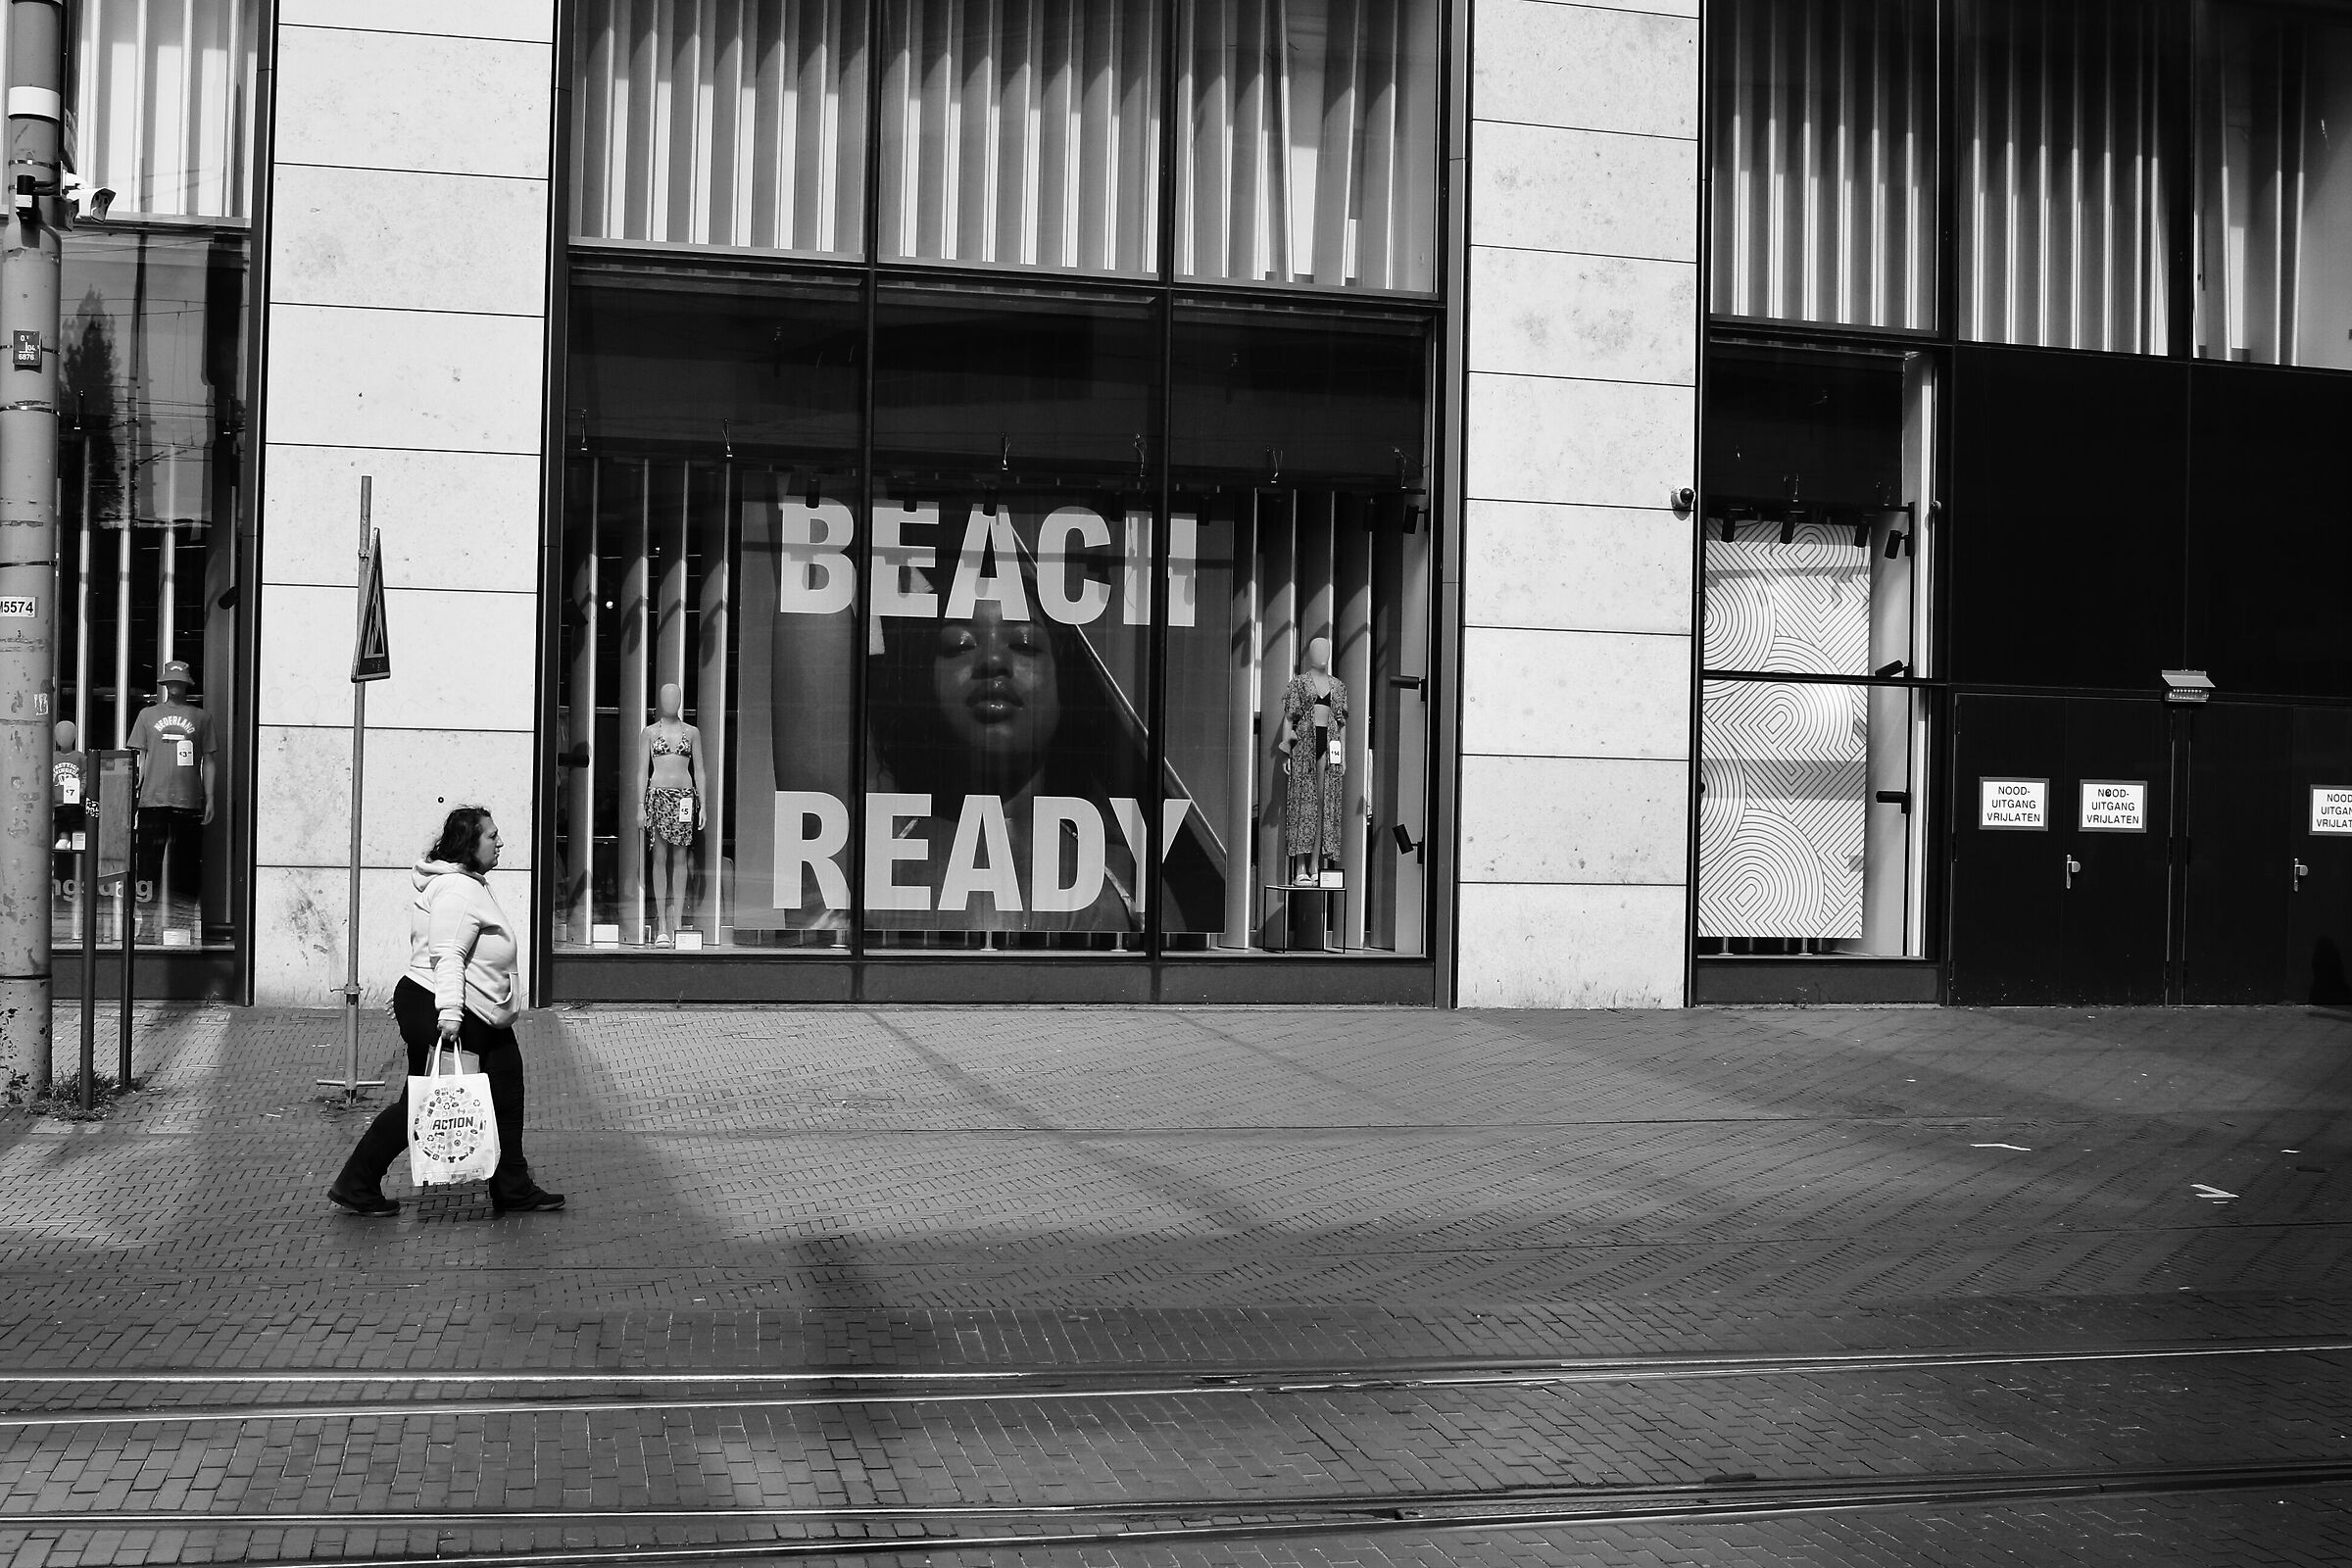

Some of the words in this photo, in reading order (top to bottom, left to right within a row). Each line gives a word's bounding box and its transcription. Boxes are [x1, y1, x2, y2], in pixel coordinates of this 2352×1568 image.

[779, 495, 1197, 627] BEACH
[154, 715, 195, 733] NEDERLAND
[1997, 786, 2031, 796] NOOD-
[1991, 799, 2036, 809] UITGANG
[2091, 802, 2135, 811] UITGANG
[1986, 812, 2040, 822] VRIJLATEN
[2086, 814, 2139, 824] VRIJLATEN
[773, 791, 1192, 913] READY
[432, 1116, 473, 1130] ACTION
